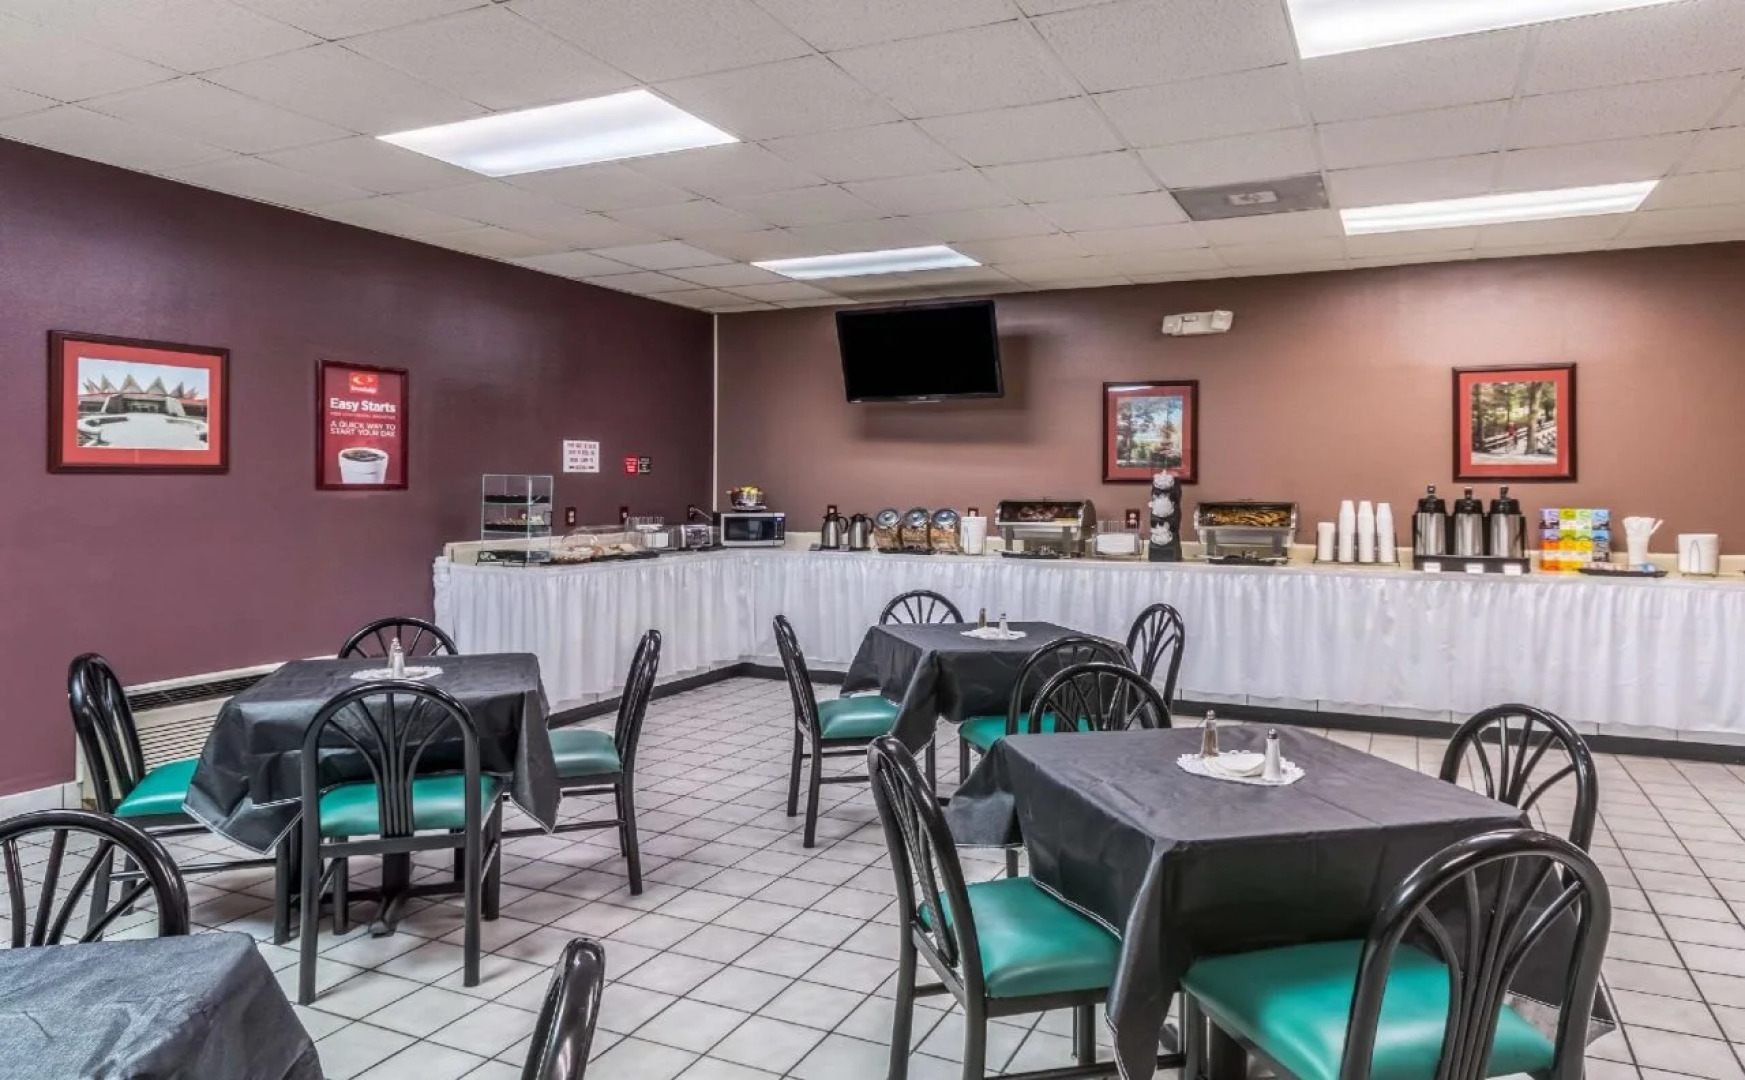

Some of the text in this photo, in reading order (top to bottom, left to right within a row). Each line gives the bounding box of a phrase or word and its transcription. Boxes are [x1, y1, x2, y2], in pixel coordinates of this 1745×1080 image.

[330, 398, 396, 413] Easy Starts
[330, 420, 337, 428] A
[339, 421, 365, 429] QUICK
[330, 427, 396, 438] START YOUR DAY
